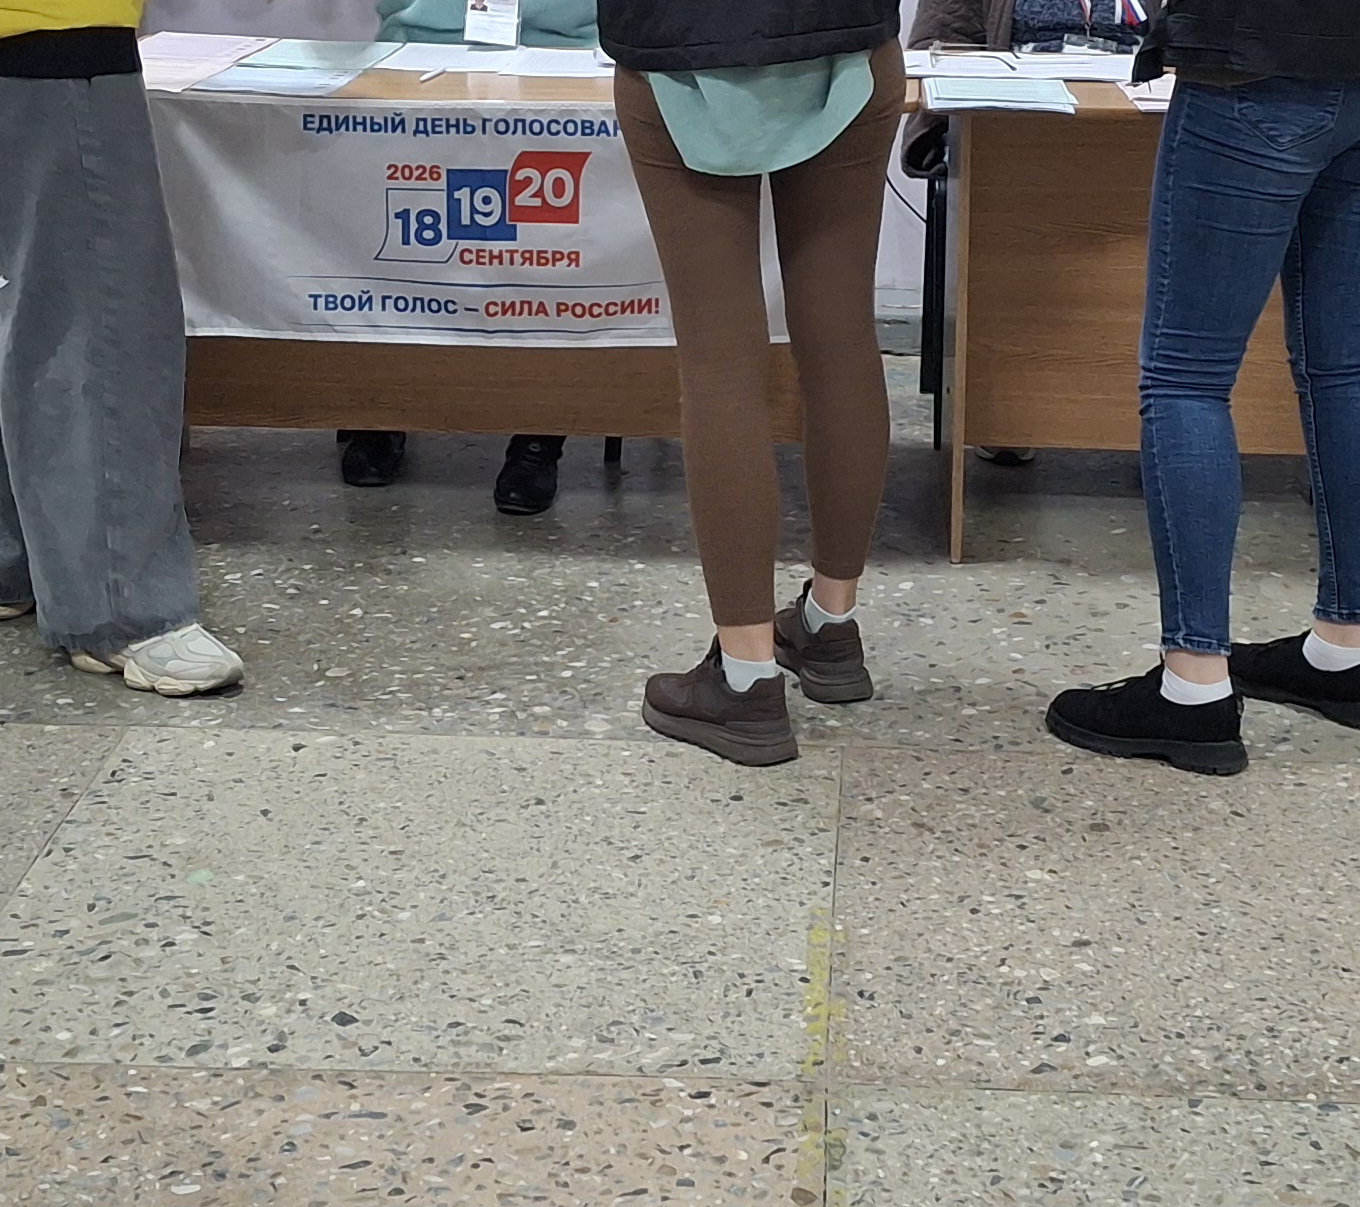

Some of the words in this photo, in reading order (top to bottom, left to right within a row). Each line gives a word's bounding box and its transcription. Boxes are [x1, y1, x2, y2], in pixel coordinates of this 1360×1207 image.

[302, 112, 406, 134] ЕДИНЫЙ
[412, 117, 476, 138] ДЕНЬ
[481, 118, 620, 138] ГОЛОСОВАН
[386, 163, 442, 182] 2026
[394, 208, 443, 247] 18
[453, 186, 503, 227] 19
[514, 167, 575, 208] 20
[459, 248, 581, 268] СЕНТЯБРЯ
[308, 290, 373, 313] ТВОЙ
[381, 294, 459, 316] ГОЛОС
[484, 300, 550, 318] СИЛА
[556, 298, 660, 319] РОССИИ!
